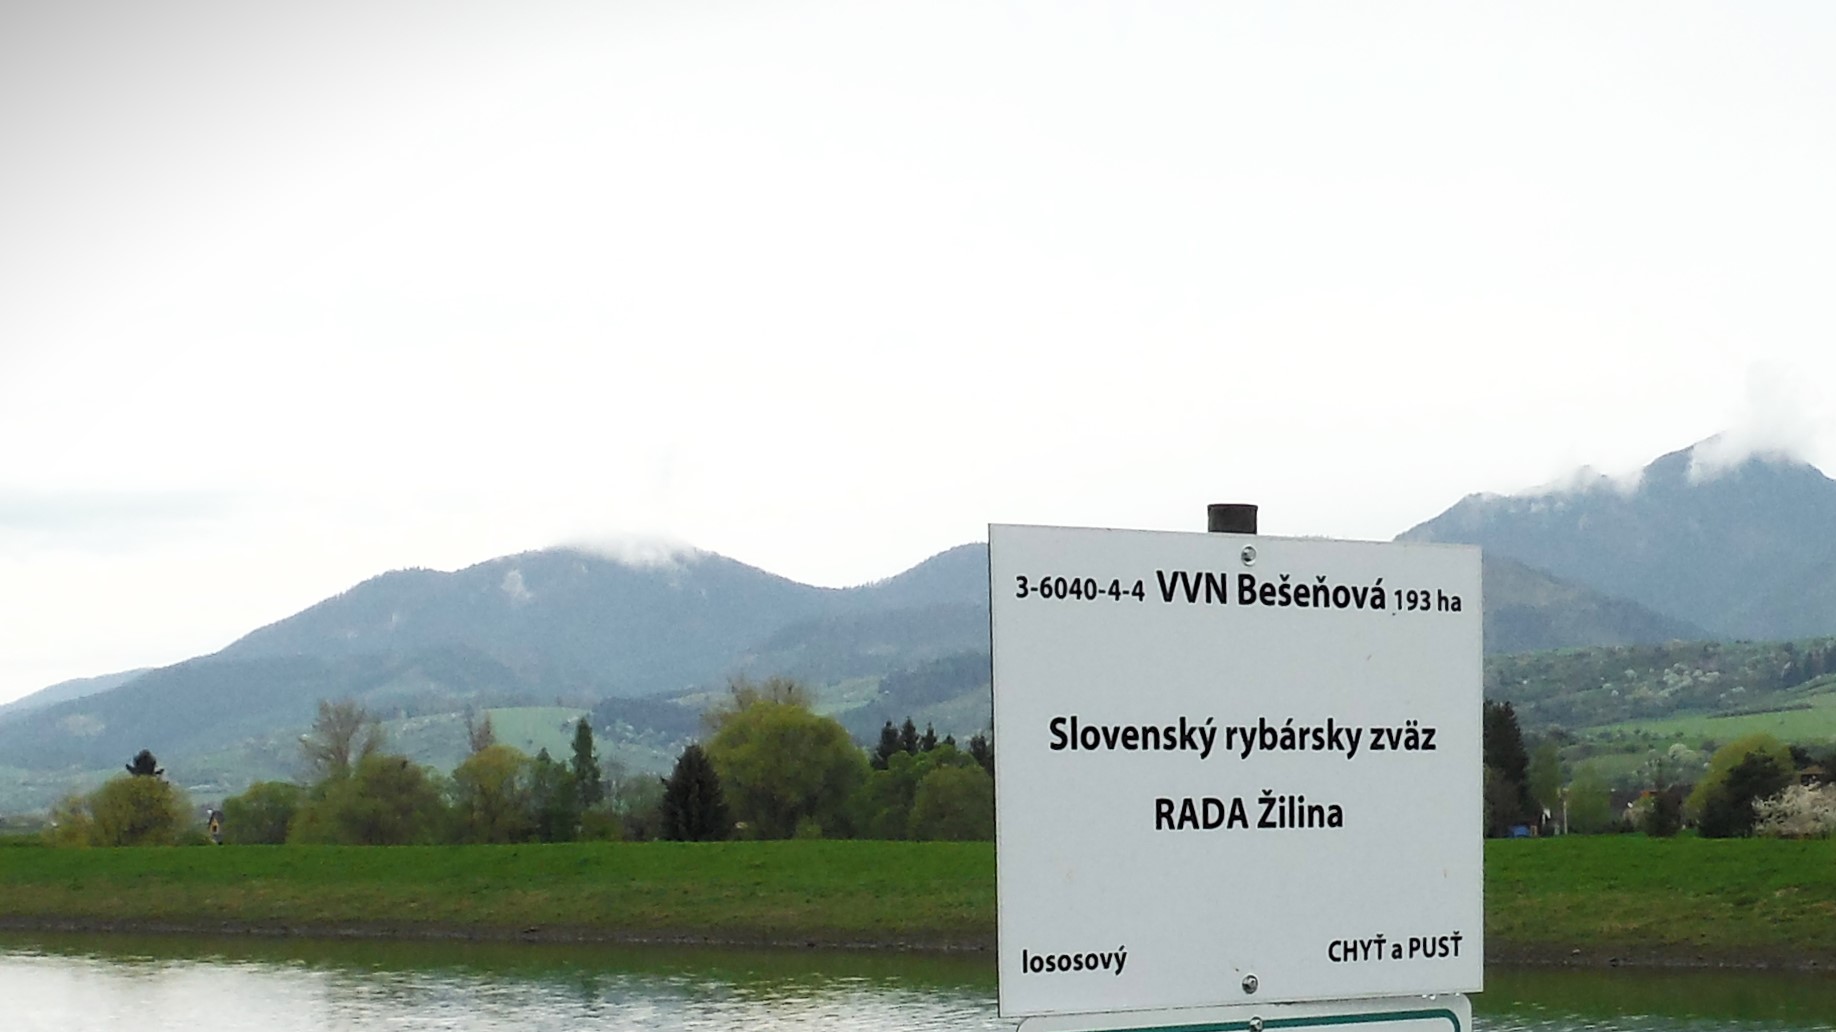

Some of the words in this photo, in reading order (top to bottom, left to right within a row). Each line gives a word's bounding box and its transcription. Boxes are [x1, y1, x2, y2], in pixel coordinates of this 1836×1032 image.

[1016, 576, 1145, 601] 3-6040-4-4
[1156, 571, 1227, 604] VVN
[1238, 574, 1385, 609] Bešeňová
[1394, 590, 1430, 612] 193
[1438, 589, 1461, 611] ha
[1050, 716, 1217, 759] Slovenský
[1226, 717, 1362, 759] rybársky
[1370, 720, 1436, 750] zväz
[1156, 798, 1248, 830] RADA
[1258, 790, 1342, 828] Žilina
[1023, 945, 1127, 975] lososový
[1329, 934, 1386, 962] CHYŤ
[1392, 944, 1402, 959] a
[1409, 931, 1462, 958] PUSŤ
